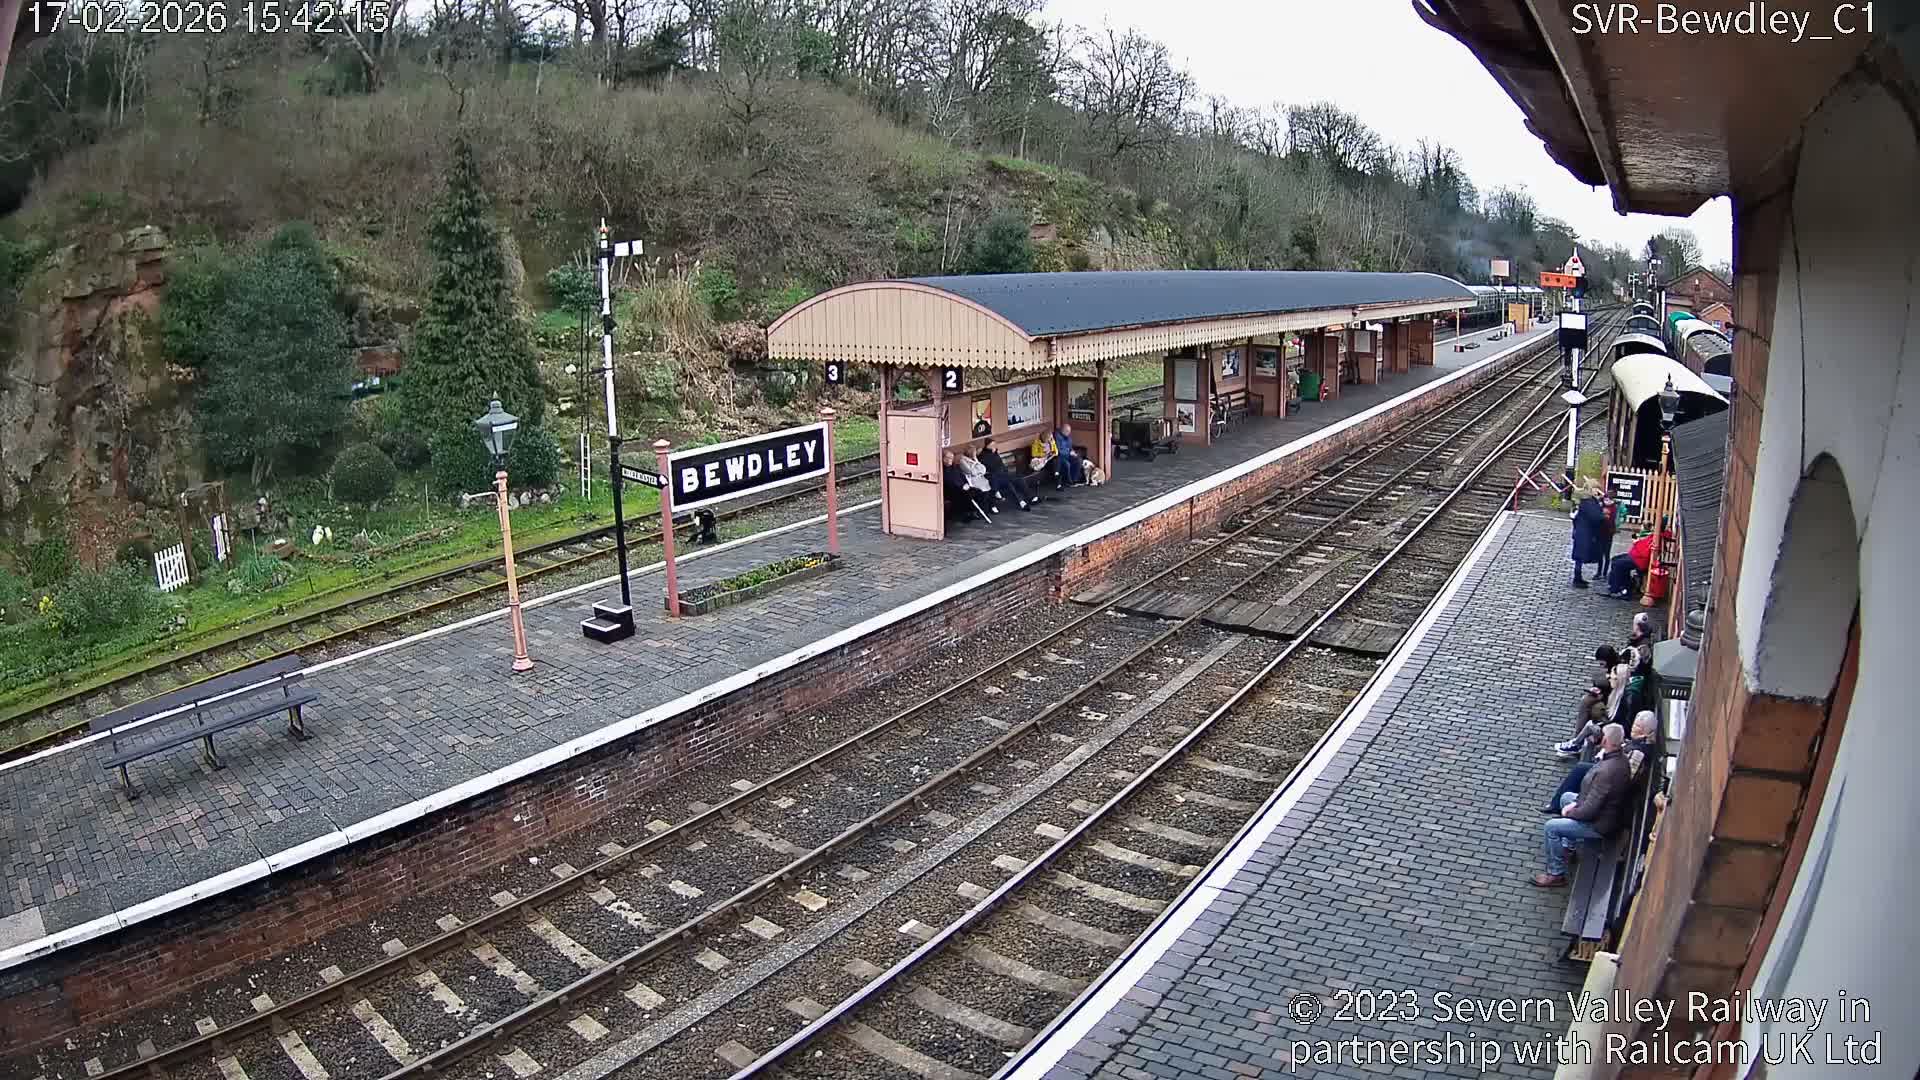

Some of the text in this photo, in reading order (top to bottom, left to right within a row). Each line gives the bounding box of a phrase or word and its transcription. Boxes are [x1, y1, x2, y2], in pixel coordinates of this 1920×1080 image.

[828, 364, 838, 381] 3
[945, 370, 957, 388] 2
[681, 439, 817, 494] BEWDLEY
